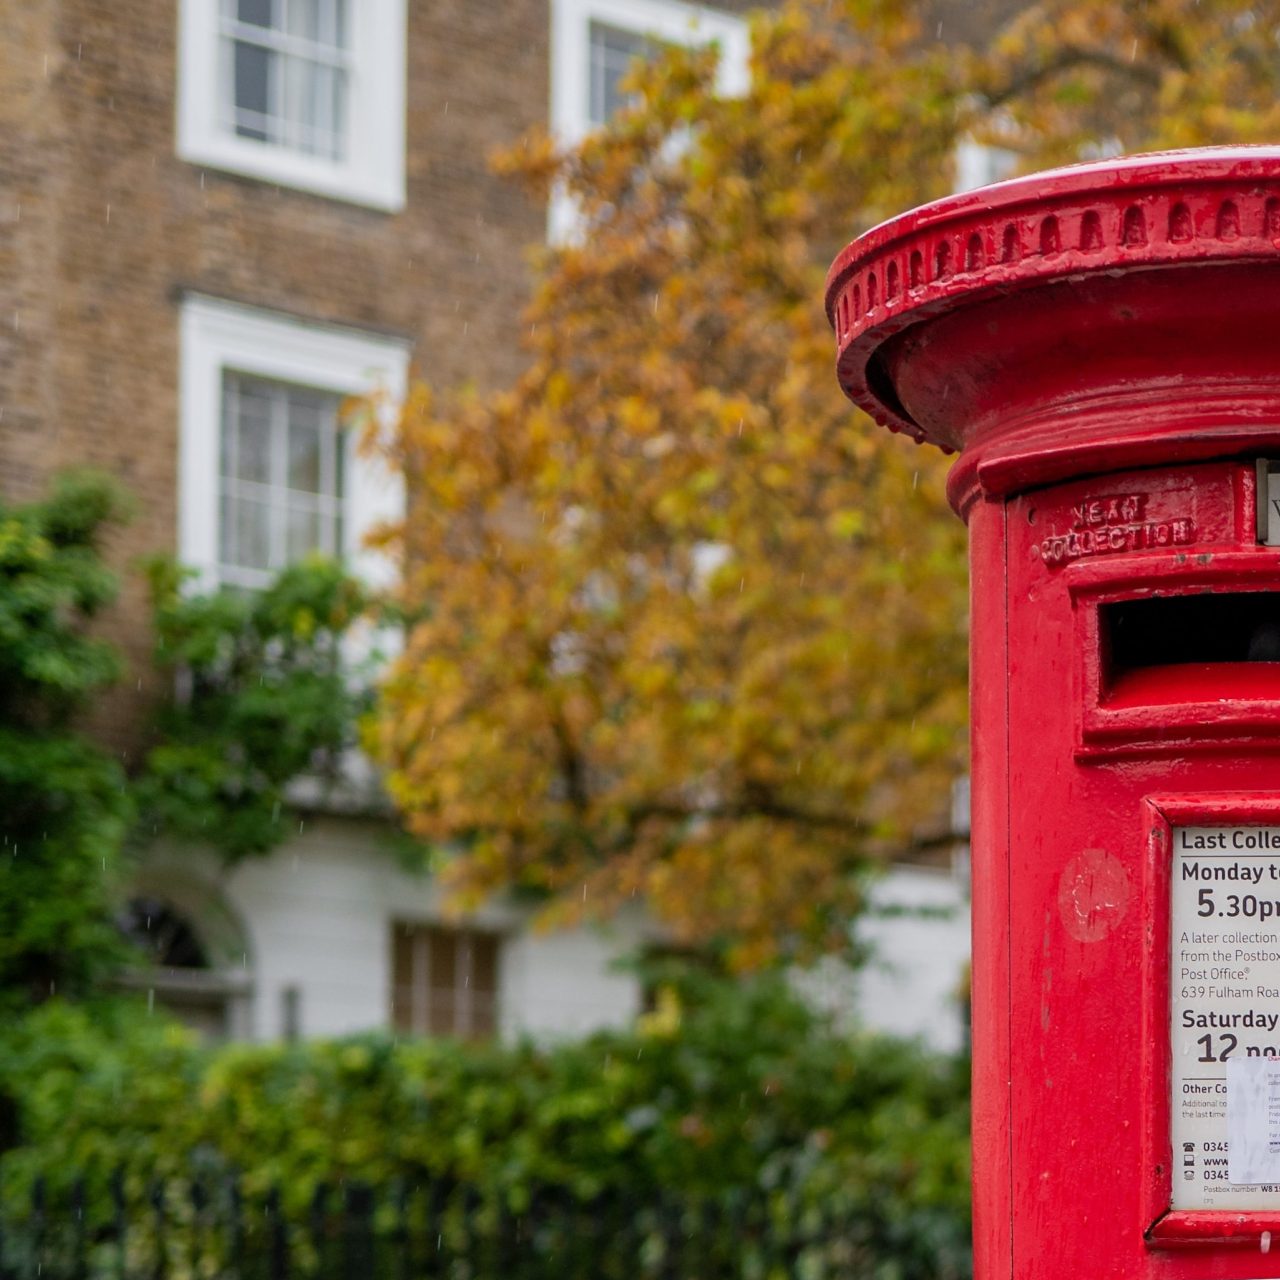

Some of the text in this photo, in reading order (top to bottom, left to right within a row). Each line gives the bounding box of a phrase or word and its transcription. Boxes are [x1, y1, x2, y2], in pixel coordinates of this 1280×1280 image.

[1181, 831, 1227, 849] Last
[1181, 862, 1264, 884] Monday
[1180, 932, 1189, 944] A
[1192, 932, 1219, 944] later
[1222, 932, 1277, 944] collection
[1180, 950, 1210, 962] from
[1212, 950, 1232, 962] the
[1181, 968, 1208, 980] Post
[1181, 986, 1205, 998] 639
[1208, 986, 1254, 998] Fulham
[1182, 1010, 1279, 1031] Saturday
[1197, 1034, 1238, 1063] 12
[1182, 1084, 1213, 1094] Other
[1182, 1100, 1218, 1108] Additional
